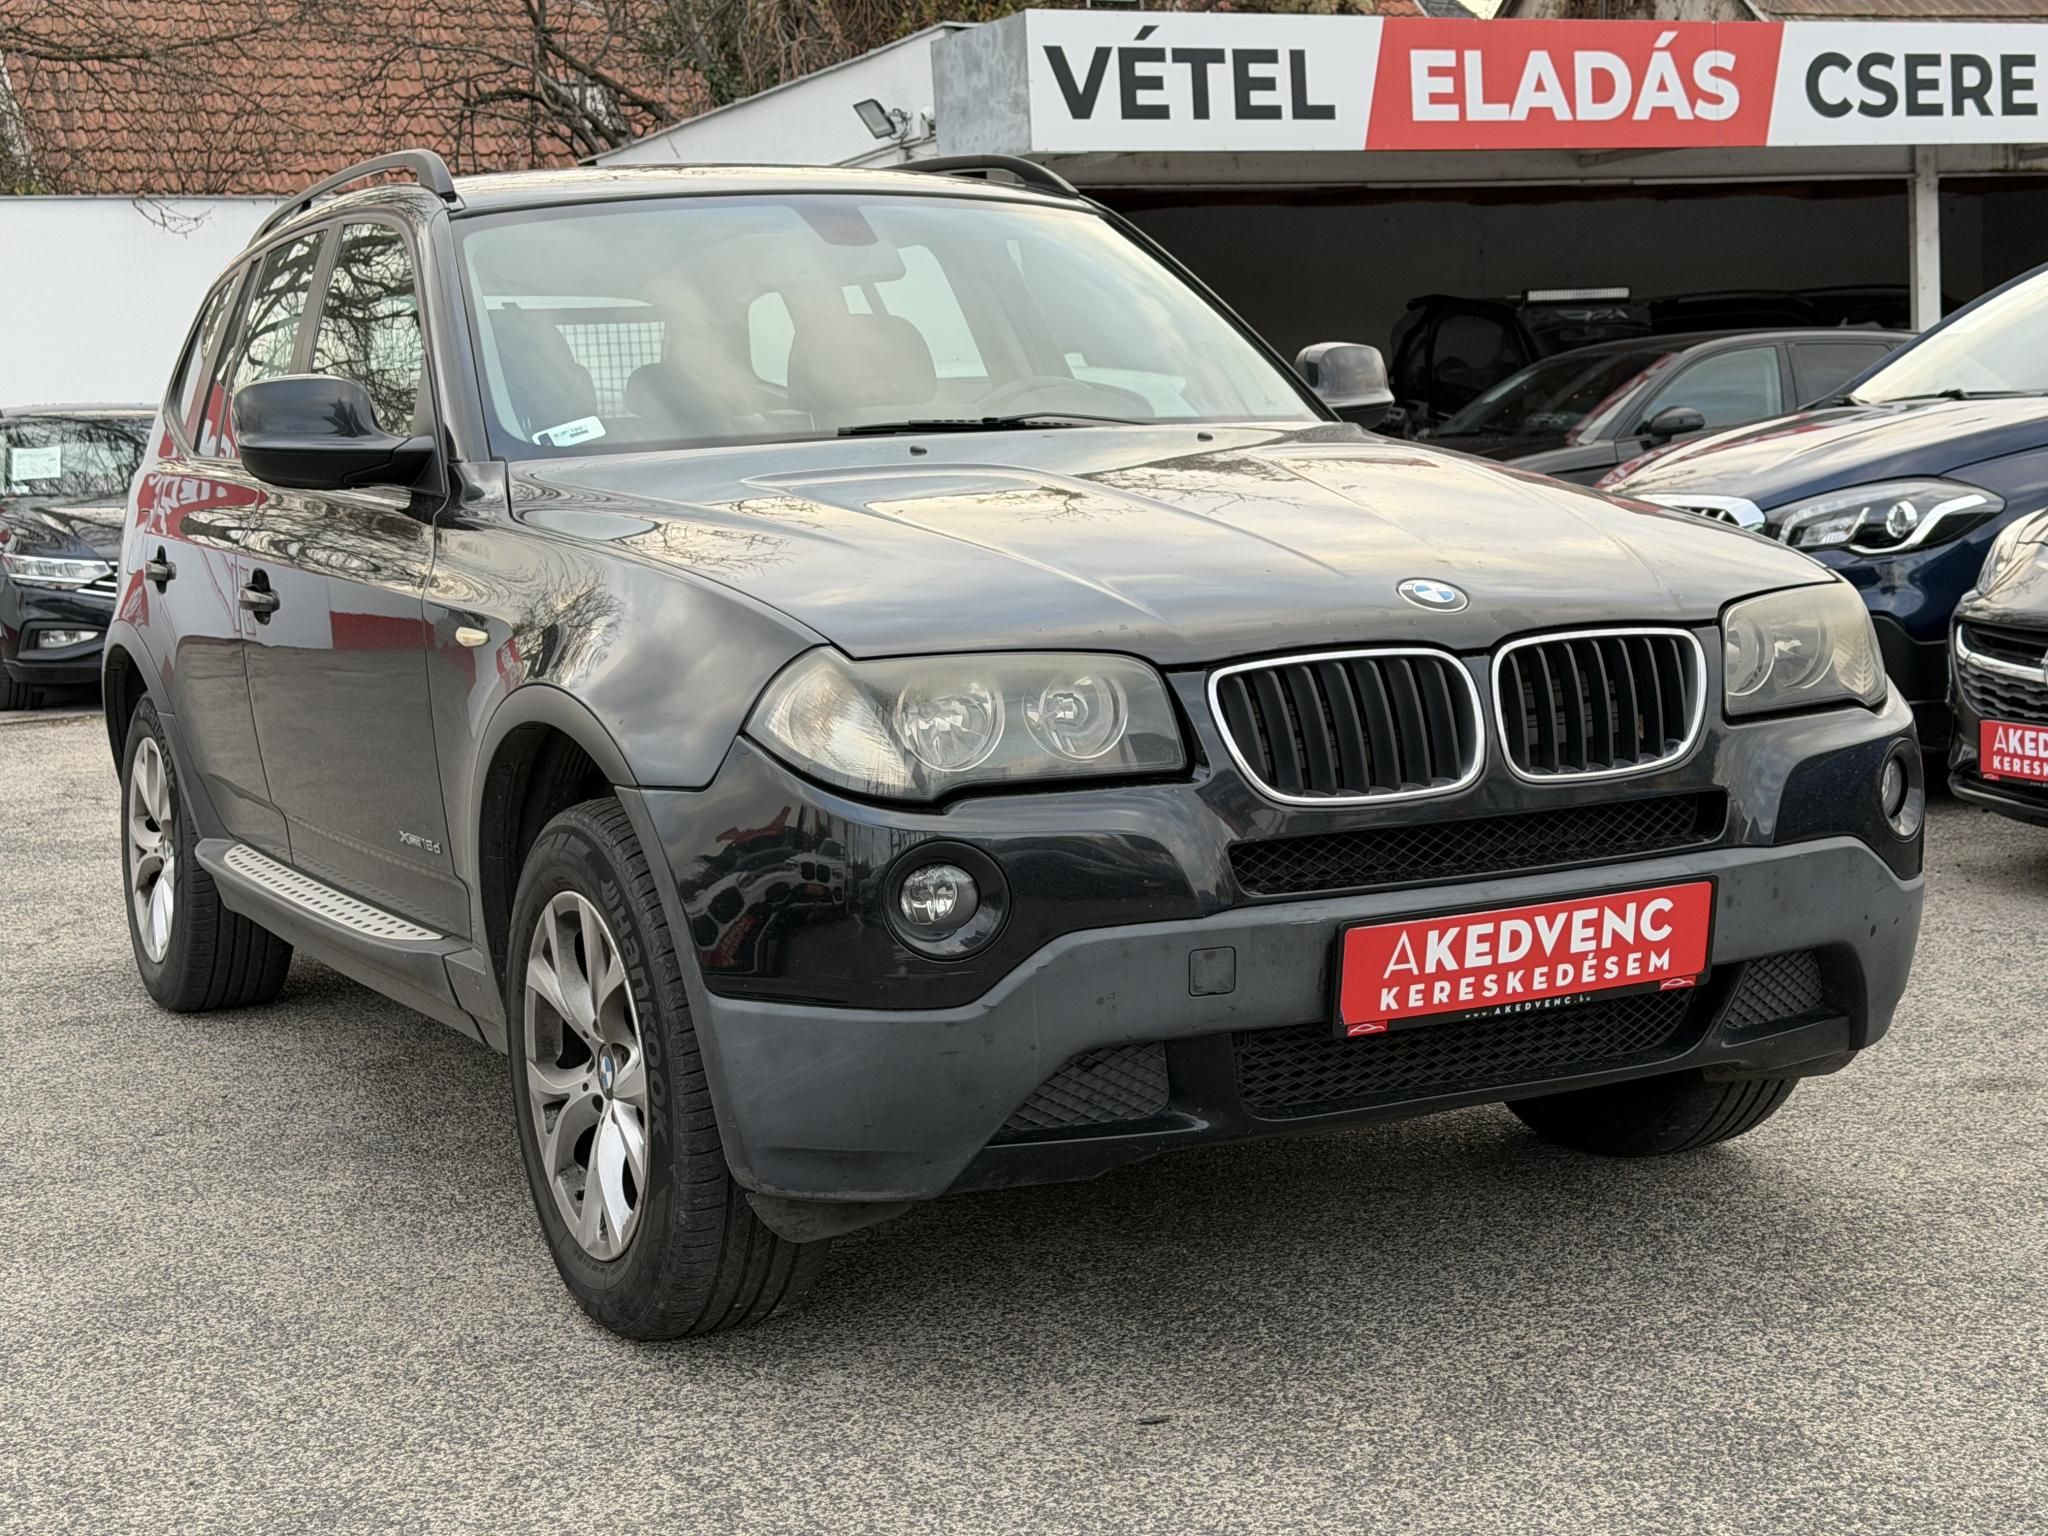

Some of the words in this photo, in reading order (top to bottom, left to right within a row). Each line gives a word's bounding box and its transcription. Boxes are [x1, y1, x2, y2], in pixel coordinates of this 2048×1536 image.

[1043, 26, 1336, 120] VÉTEL
[1409, 31, 1740, 122] ELADÁS
[1805, 52, 2038, 118] CSERE
[1383, 897, 1674, 979] AKEDVENC
[1379, 948, 1671, 1011] KERESKEDÉSEM
